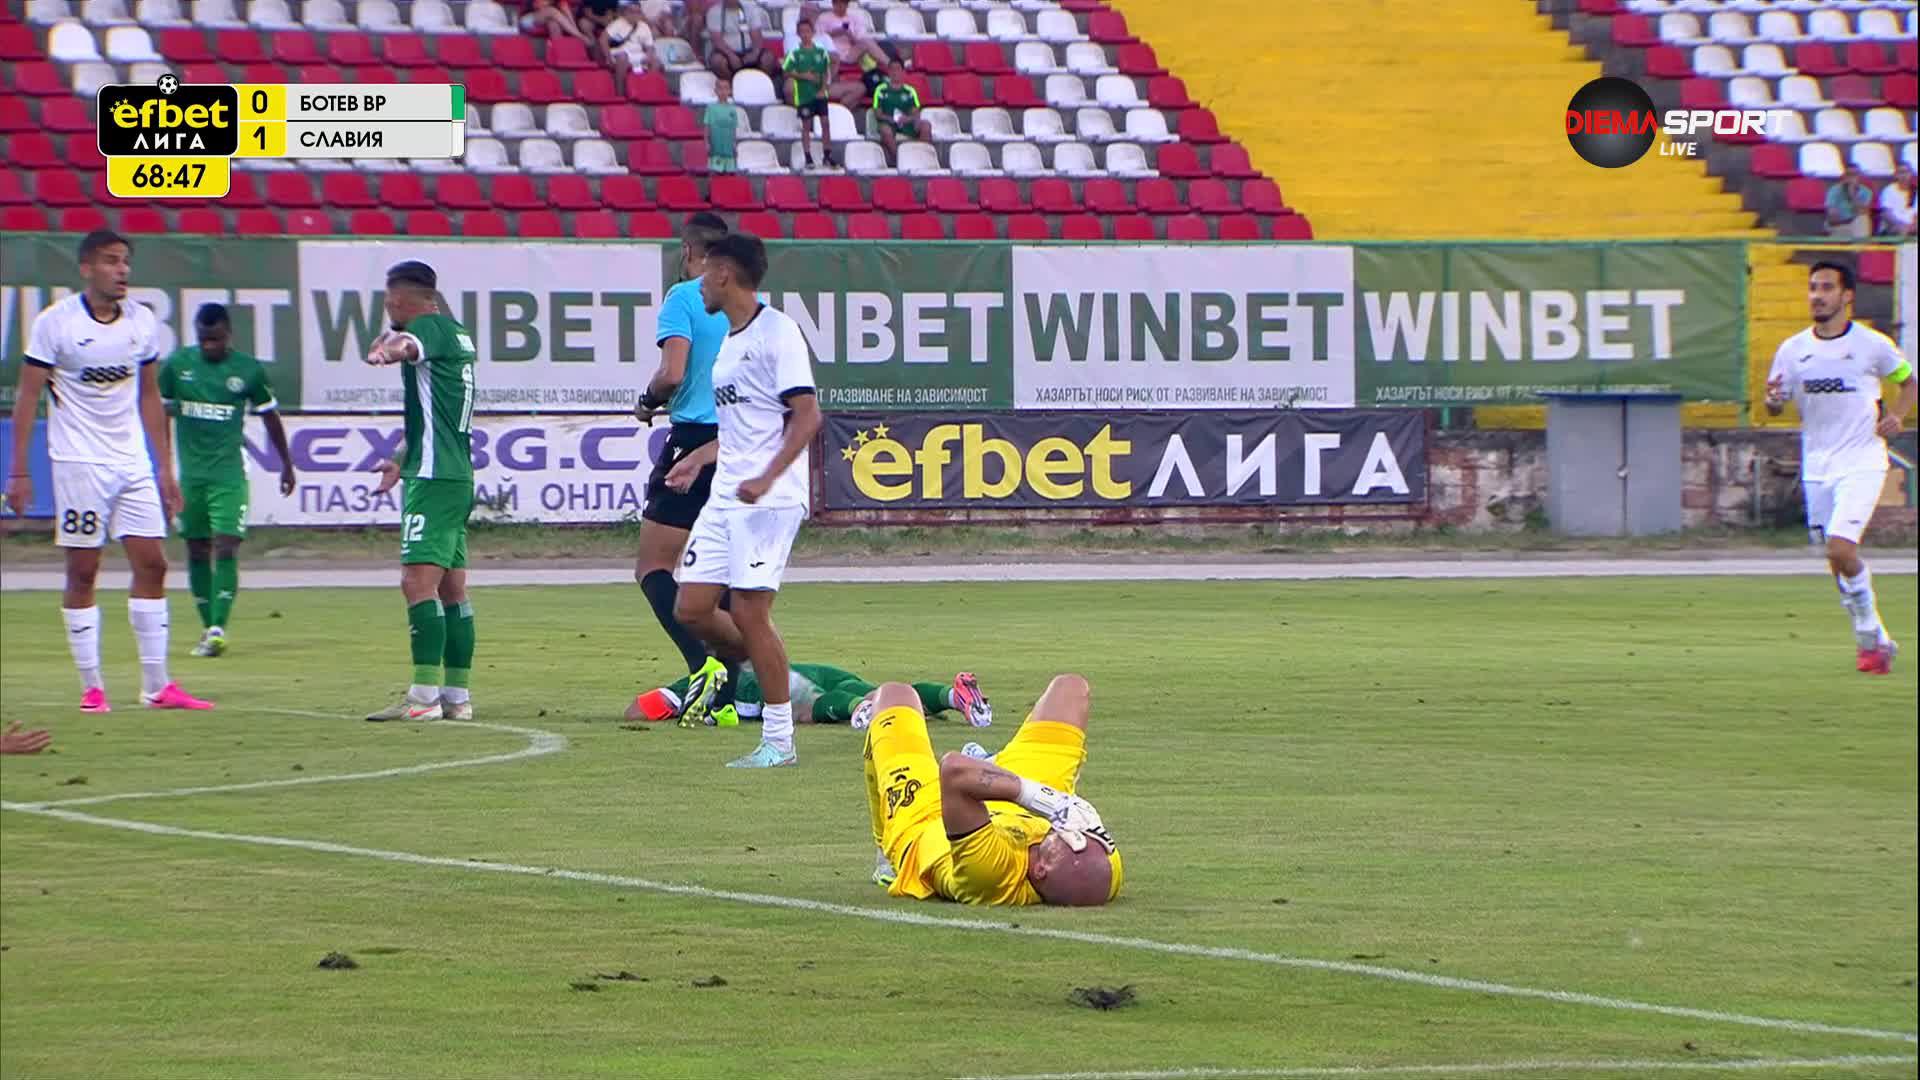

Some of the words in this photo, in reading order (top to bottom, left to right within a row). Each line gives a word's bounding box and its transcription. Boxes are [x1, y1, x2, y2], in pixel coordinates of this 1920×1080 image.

[1023, 292, 1345, 362] WINBET
[1363, 290, 1686, 361] WINBET
[830, 388, 894, 403] РАЗВИВАНЕ
[897, 388, 912, 403] НА
[914, 388, 988, 403] ЗАВИСИМОСТ
[1036, 387, 1093, 402] ХАЗАРТЪТ
[1095, 387, 1123, 402] НОСИ
[1126, 387, 1153, 402] РИСК
[1156, 387, 1170, 402] ОТ
[1175, 387, 1238, 402] РАЗВИВАНЕ
[1240, 387, 1255, 402] НА
[852, 423, 1132, 501] efbet
[1147, 432, 1410, 498] ЛИГА
[540, 483, 650, 511] ОНЛА
[63, 508, 97, 535] 88
[403, 514, 425, 541] 12
